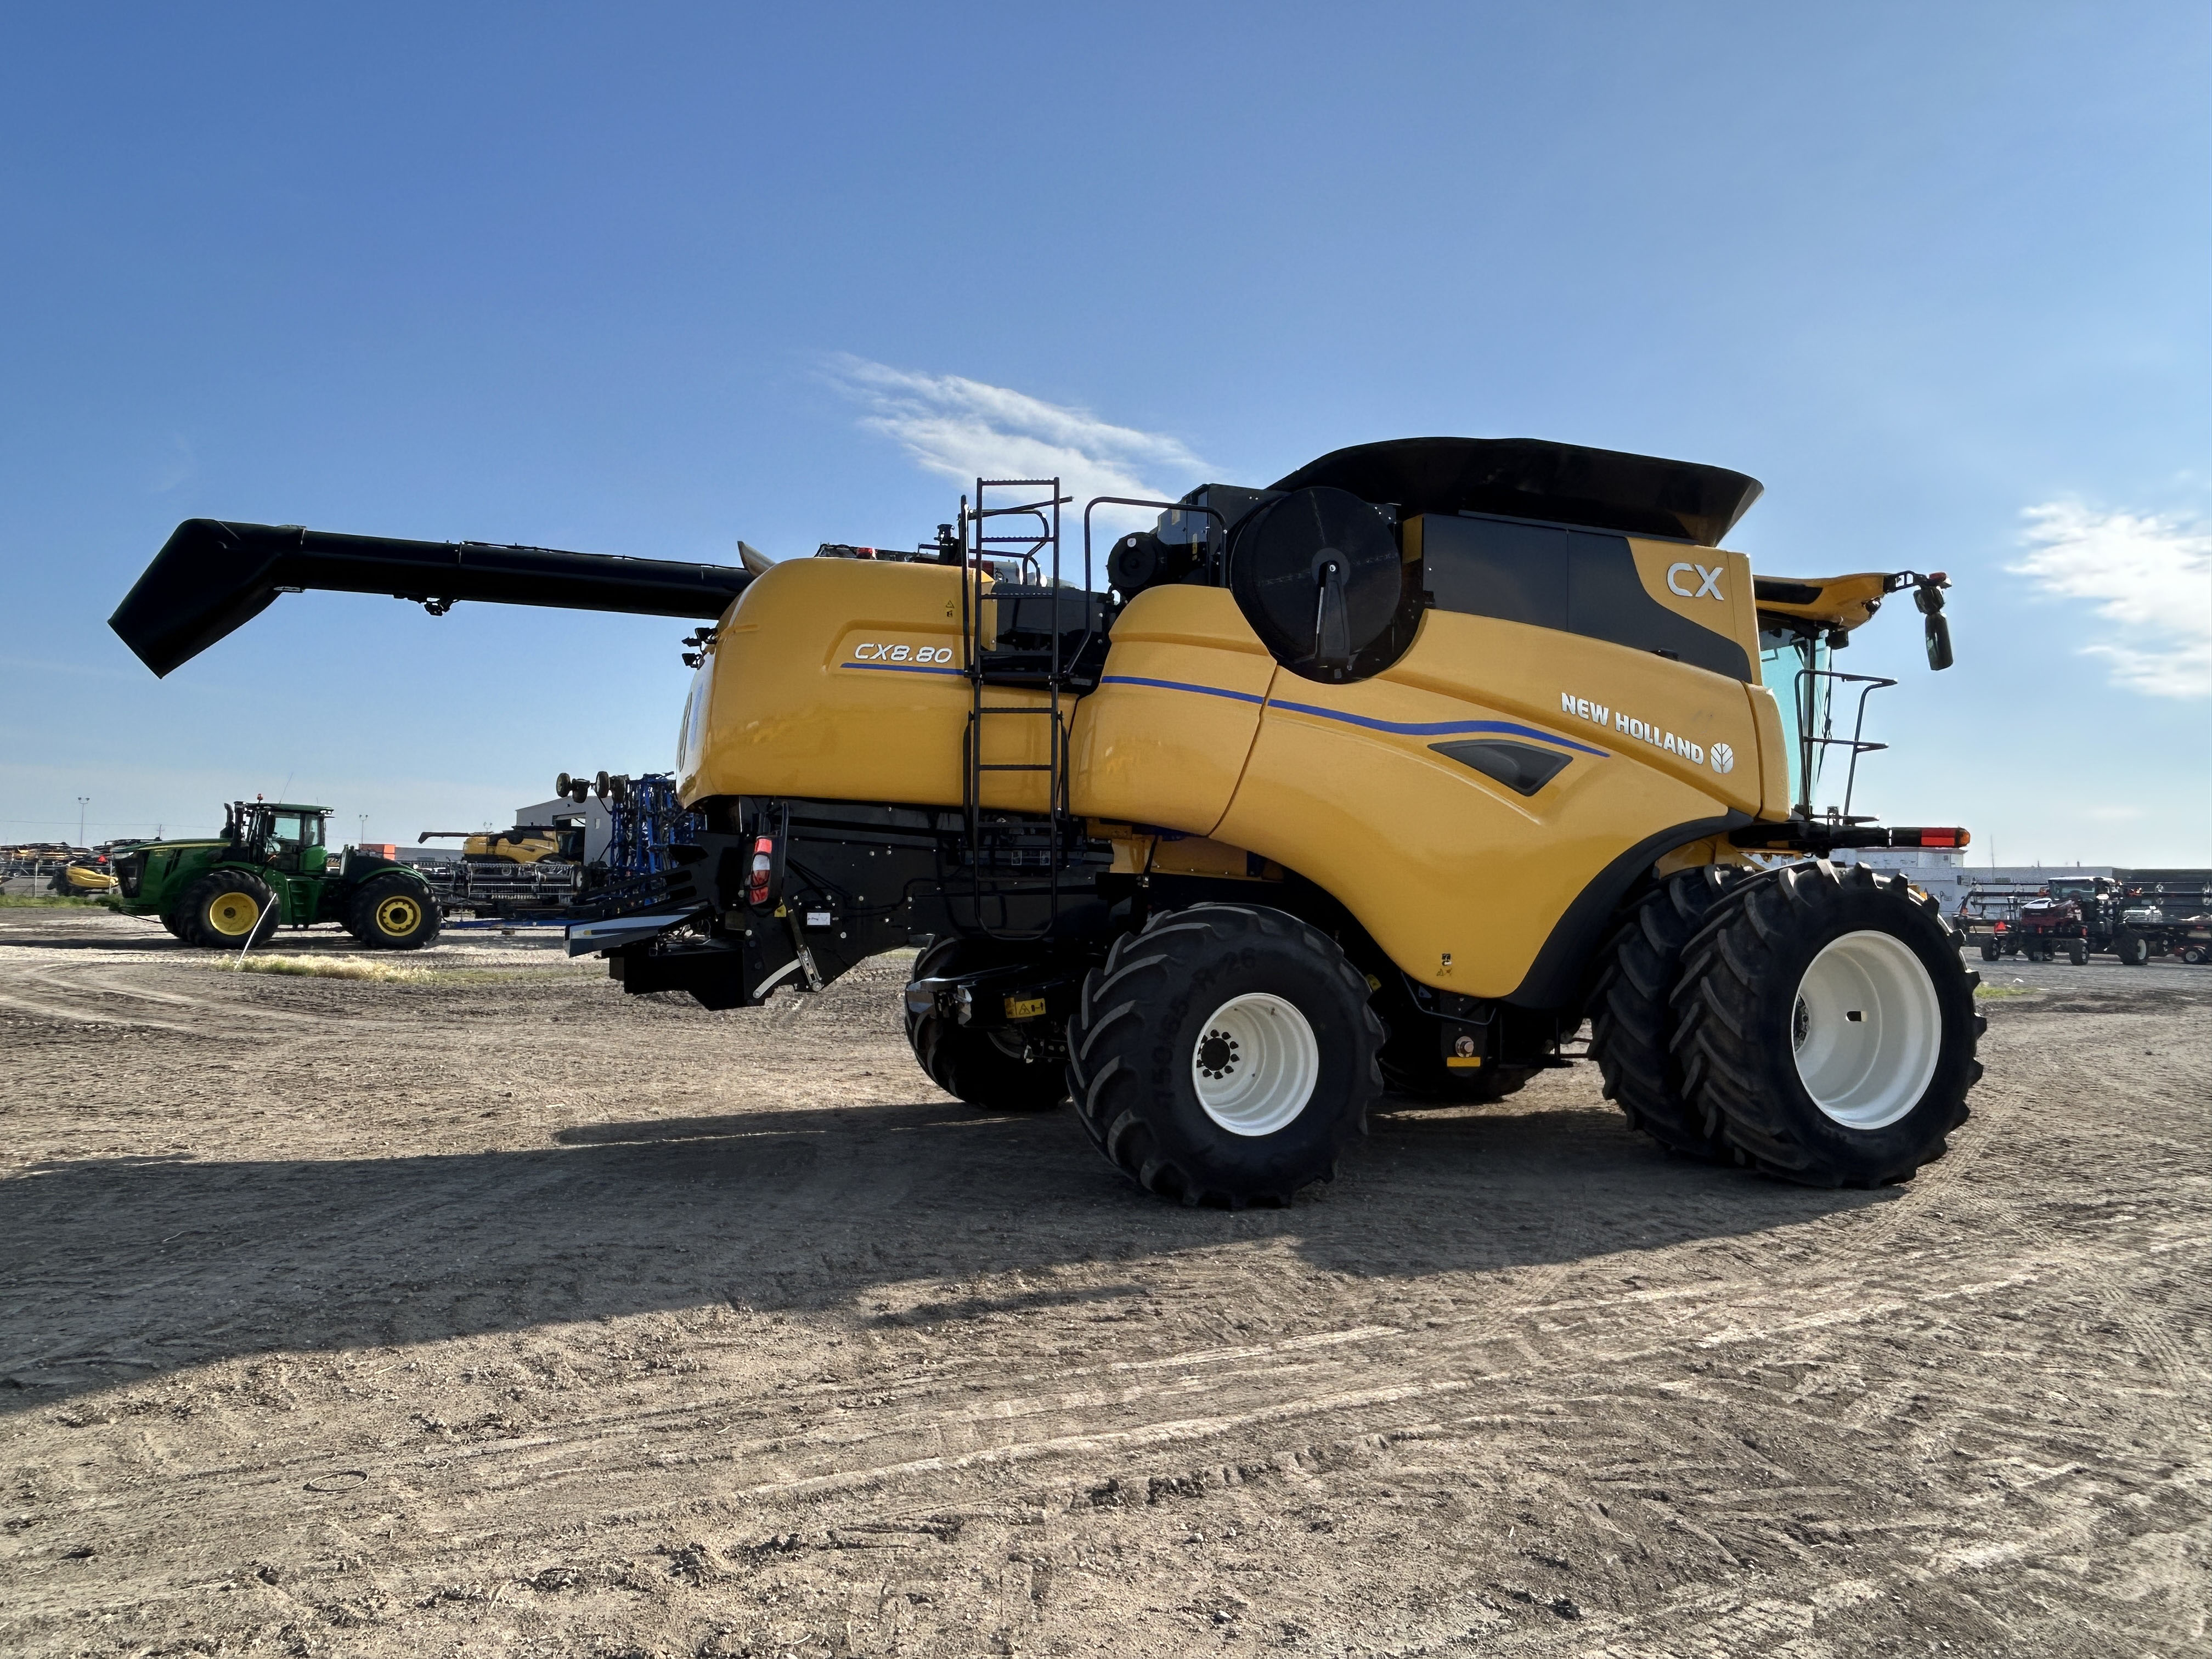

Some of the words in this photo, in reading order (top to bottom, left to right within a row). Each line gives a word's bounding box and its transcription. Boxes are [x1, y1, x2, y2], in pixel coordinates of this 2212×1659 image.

[1667, 562, 1724, 601] CX
[855, 643, 952, 663] CX8.80
[1561, 692, 1609, 726] NEW
[1615, 712, 1705, 765] HOLLAND
